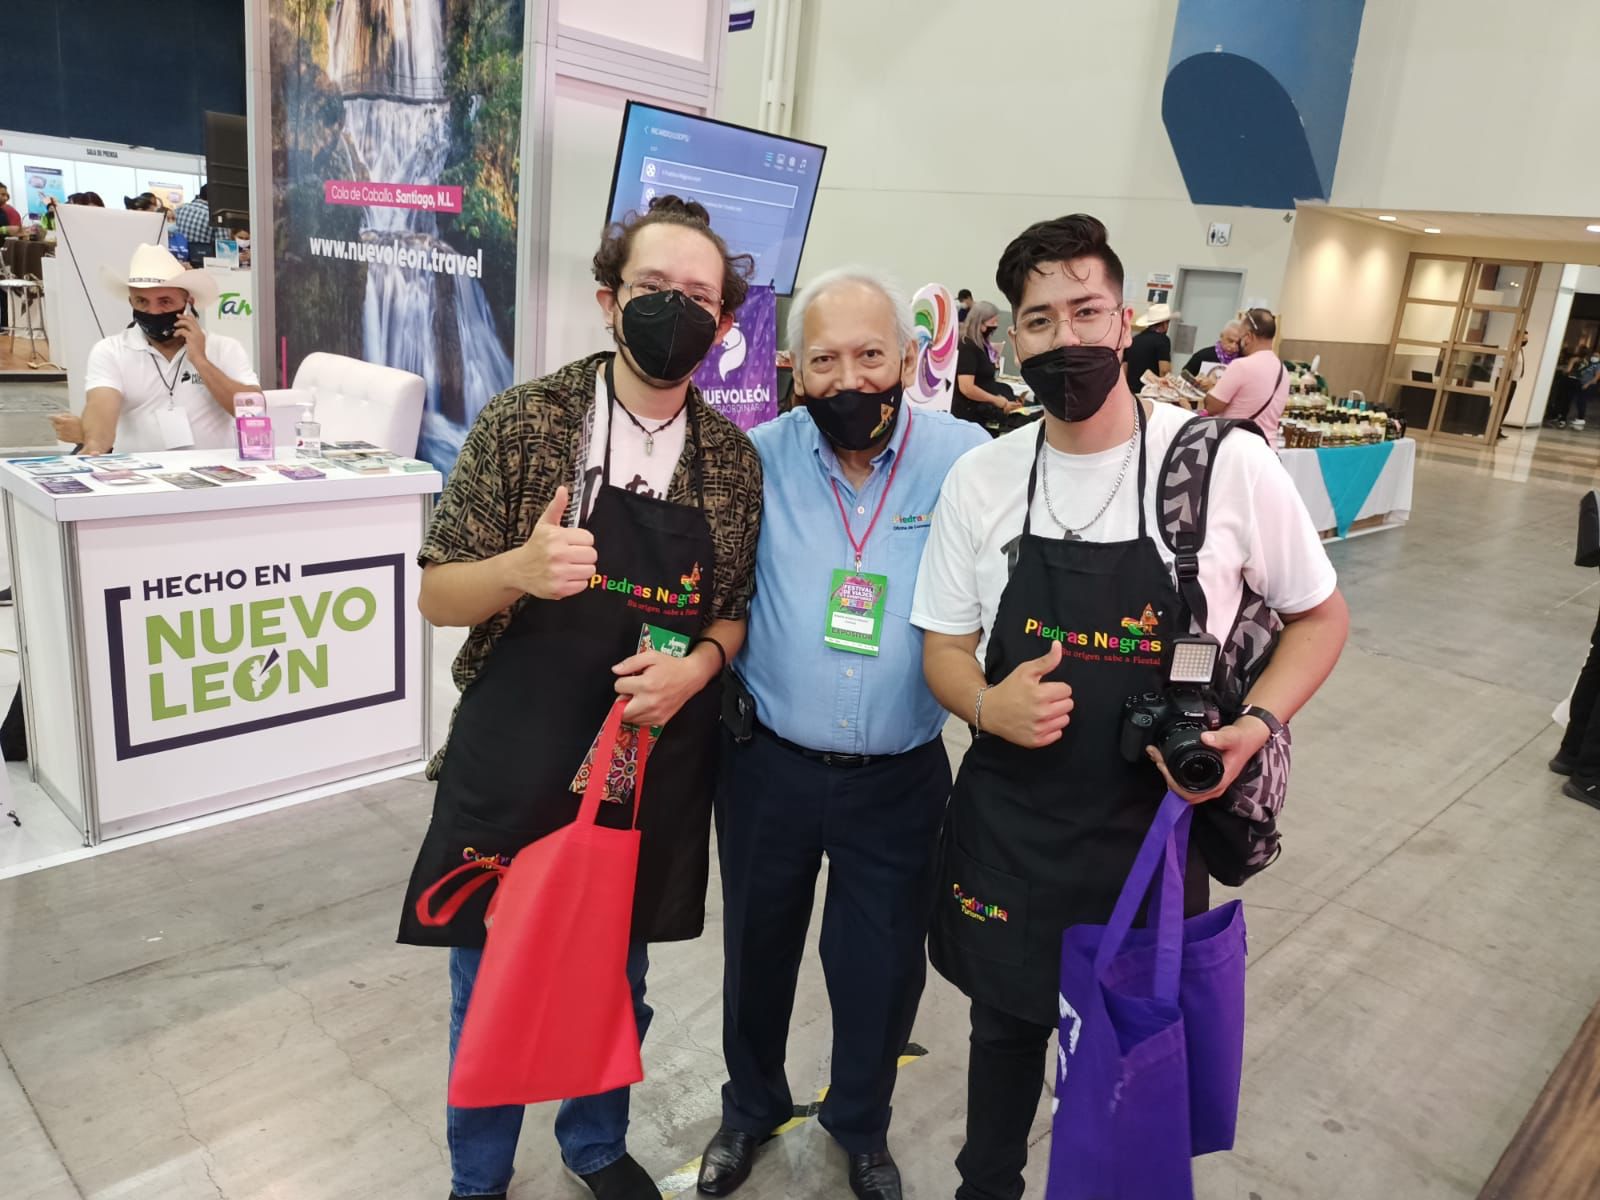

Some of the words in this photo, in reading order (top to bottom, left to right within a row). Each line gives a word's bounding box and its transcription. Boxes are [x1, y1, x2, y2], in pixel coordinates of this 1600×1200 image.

[331, 185, 349, 200] Cola
[350, 187, 361, 200] de
[395, 189, 436, 209] Santiago,
[437, 191, 455, 207] N.L.
[309, 237, 483, 278] www.nuevoleon.travel
[142, 568, 247, 601] HECHO
[255, 562, 291, 587] EN
[589, 573, 652, 599] Piedras
[656, 586, 701, 608] Negras
[145, 586, 377, 666] NUEVO
[1024, 618, 1088, 646] Piedras
[1094, 631, 1162, 654] Negras
[149, 644, 329, 721] LEÓN
